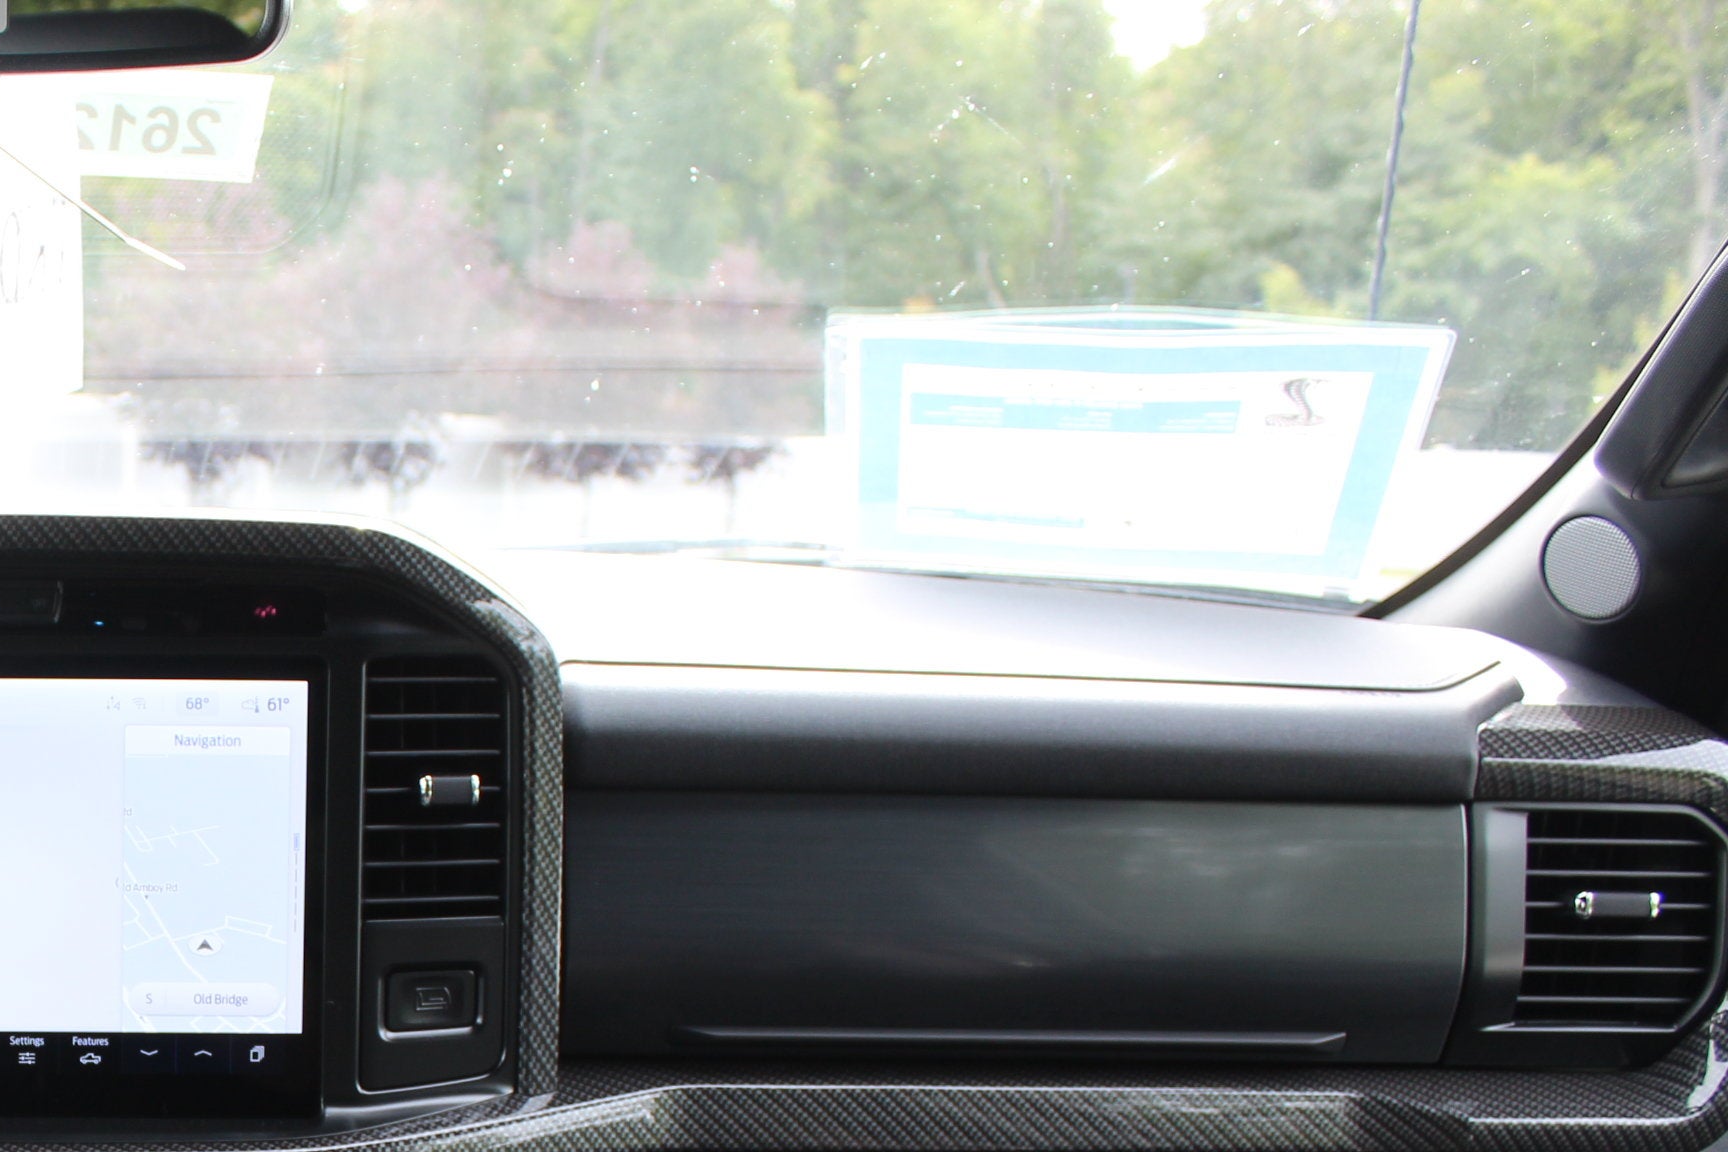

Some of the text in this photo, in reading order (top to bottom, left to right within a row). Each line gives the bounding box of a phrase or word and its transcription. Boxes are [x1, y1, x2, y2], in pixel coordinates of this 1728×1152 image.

[185, 697, 210, 711] 68°
[267, 697, 290, 711] 61°
[174, 733, 242, 750] Navigation
[165, 883, 178, 893] Rd
[145, 993, 153, 1005] S
[193, 992, 249, 1009] Old Bridge
[9, 1035, 45, 1048] Settings
[72, 1035, 110, 1047] Features
